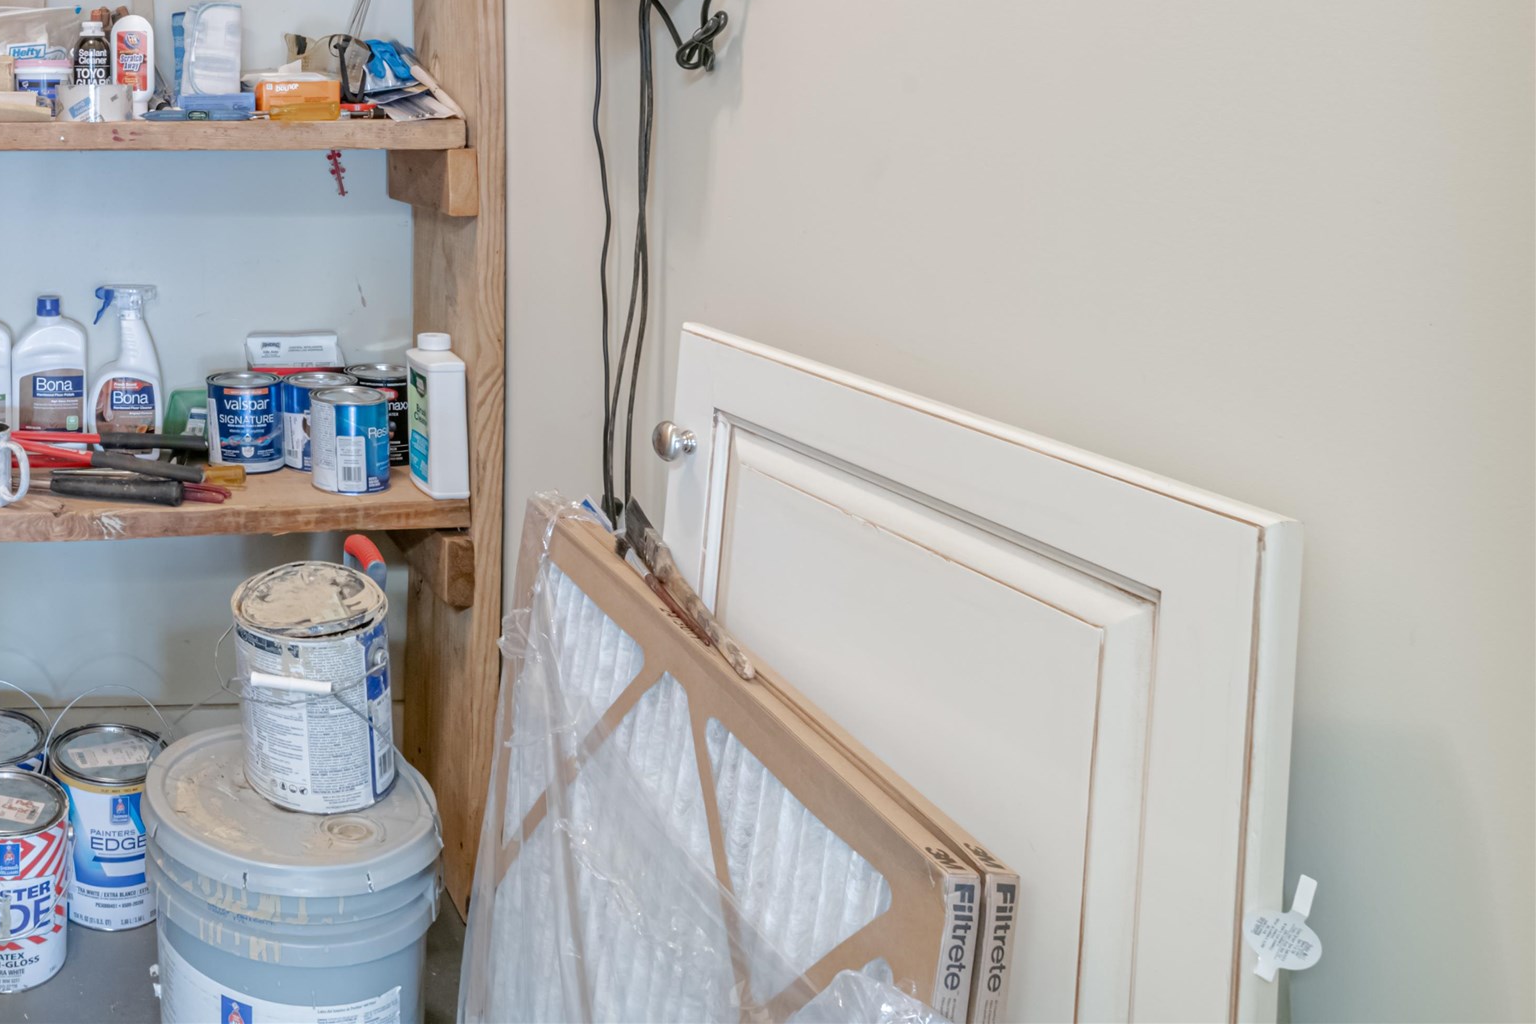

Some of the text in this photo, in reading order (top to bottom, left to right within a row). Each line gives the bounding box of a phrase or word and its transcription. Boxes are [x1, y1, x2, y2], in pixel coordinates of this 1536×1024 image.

[13, 47, 41, 58] Hefty
[78, 48, 107, 57] Sealant
[119, 54, 143, 63] Scratch
[78, 57, 107, 65] Cleaner
[124, 63, 140, 71] Away
[76, 68, 105, 78] TOYO
[275, 83, 299, 92] bounce
[36, 377, 73, 391] Bona
[113, 391, 148, 404] Bona
[224, 396, 270, 413] valspar
[219, 414, 274, 424] SIGNATURE
[368, 426, 388, 439] Res
[90, 828, 136, 837] PAINTERS
[91, 834, 146, 851] EDGE
[925, 846, 967, 871] 3M
[964, 842, 1006, 870] 3M
[944, 883, 976, 991] Filtrete
[987, 883, 1016, 992] Filtrete
